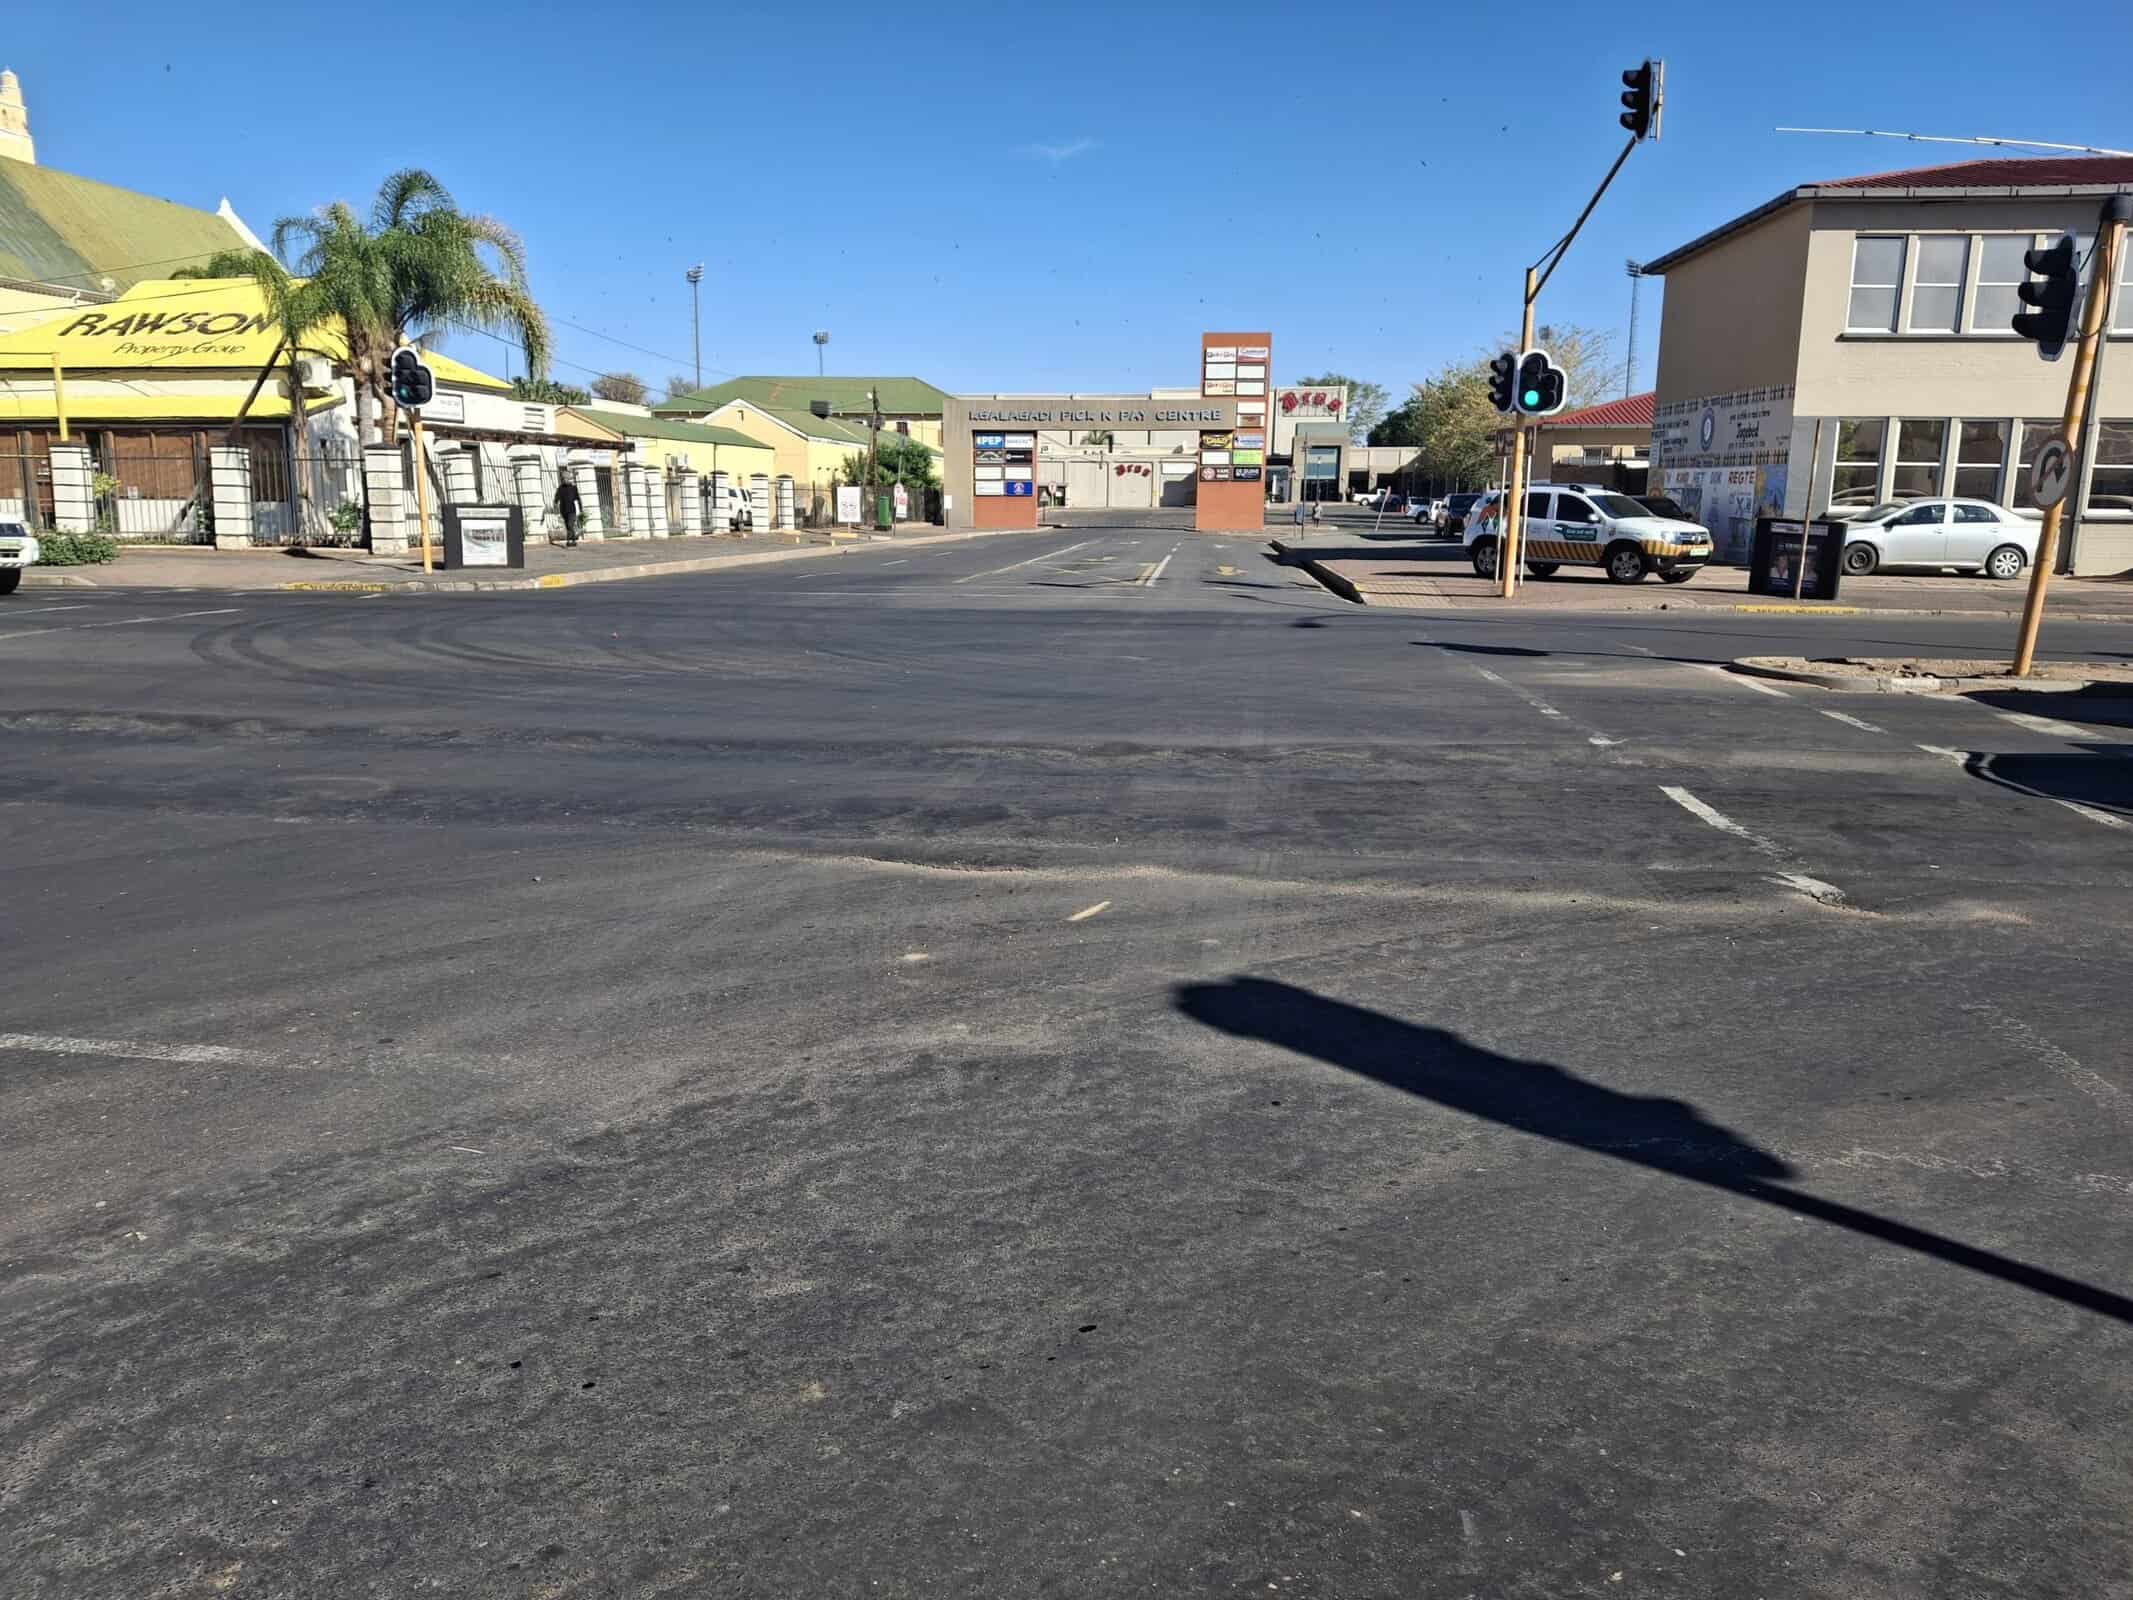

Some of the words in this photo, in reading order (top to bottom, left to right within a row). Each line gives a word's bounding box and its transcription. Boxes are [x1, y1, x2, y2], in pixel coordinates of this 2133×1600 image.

[58, 312, 281, 336] RAWSON
[113, 342, 187, 355] Property
[191, 341, 245, 354] Group
[968, 409, 1052, 421] KGALAGADI
[1060, 409, 1094, 421] PICK
[1100, 409, 1112, 421] N
[1118, 409, 1146, 421] PAY
[1155, 409, 1222, 421] CENTRE
[981, 435, 1002, 445] PEP
[1727, 471, 1756, 485] REGTE
